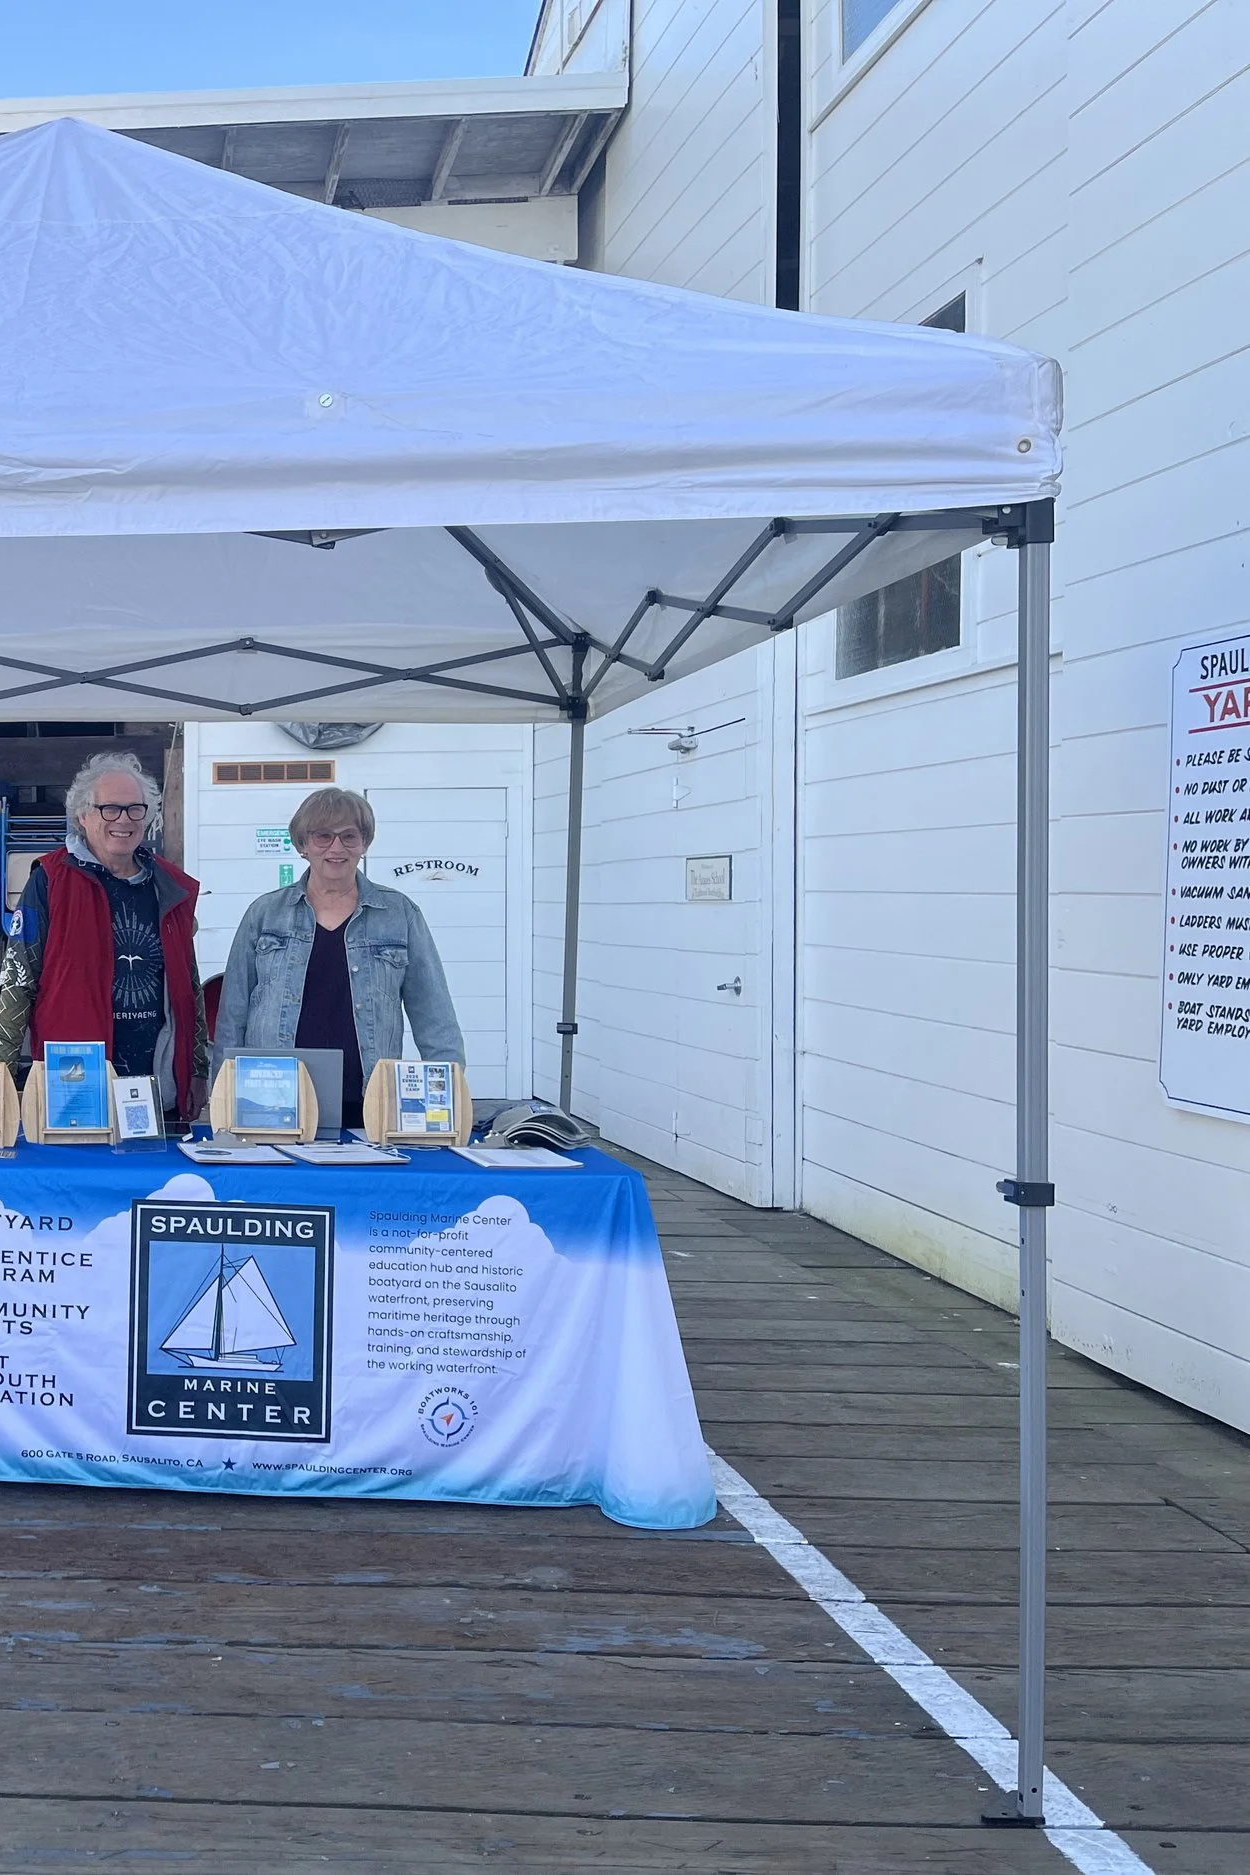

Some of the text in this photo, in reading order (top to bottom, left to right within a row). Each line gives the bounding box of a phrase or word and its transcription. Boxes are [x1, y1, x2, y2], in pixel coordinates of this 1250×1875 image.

[1200, 648, 1249, 680] SPAUL
[1186, 750, 1225, 767] PLEASE
[1227, 749, 1242, 763] BE
[1184, 778, 1247, 795] NO DUST OR
[1183, 812, 1200, 824] ALL
[1205, 808, 1237, 824] WORK
[1182, 838, 1249, 853] NO WORK BY
[394, 860, 479, 876] RESTROOM
[1181, 855, 1225, 869] OWNERS
[1181, 886, 1224, 899] VACUUM
[1179, 915, 1250, 931] LADDERS MUS
[1179, 943, 1244, 960] USE PROPER
[1178, 972, 1204, 985] ONLY
[1208, 974, 1233, 988] YARD
[1178, 1001, 1250, 1022] BOAT STANDS
[1177, 1017, 1203, 1032] YARD
[369, 1210, 512, 1226] Spaulding Marine Center
[150, 1216, 314, 1239] SPAULDING
[369, 1228, 469, 1242] is a not-for-profit
[369, 1245, 493, 1258] community-centered
[369, 1260, 523, 1276] education hub and historic
[368, 1276, 517, 1293] boatyard on the Sausalito
[368, 1294, 494, 1311] waterfront, preserving
[368, 1310, 520, 1328] maritime heritage through
[368, 1326, 514, 1344] hands-on craftsmanship,
[367, 1343, 527, 1360] training, and stewardship of
[367, 1360, 498, 1374] the working waterfront.
[184, 1379, 276, 1395] MARINE
[418, 1387, 478, 1415] BOATWORKS 101
[147, 1400, 311, 1424] CENTER
[21, 1450, 43, 1458] 600
[46, 1450, 73, 1459] GATE
[186, 1459, 203, 1467] CA
